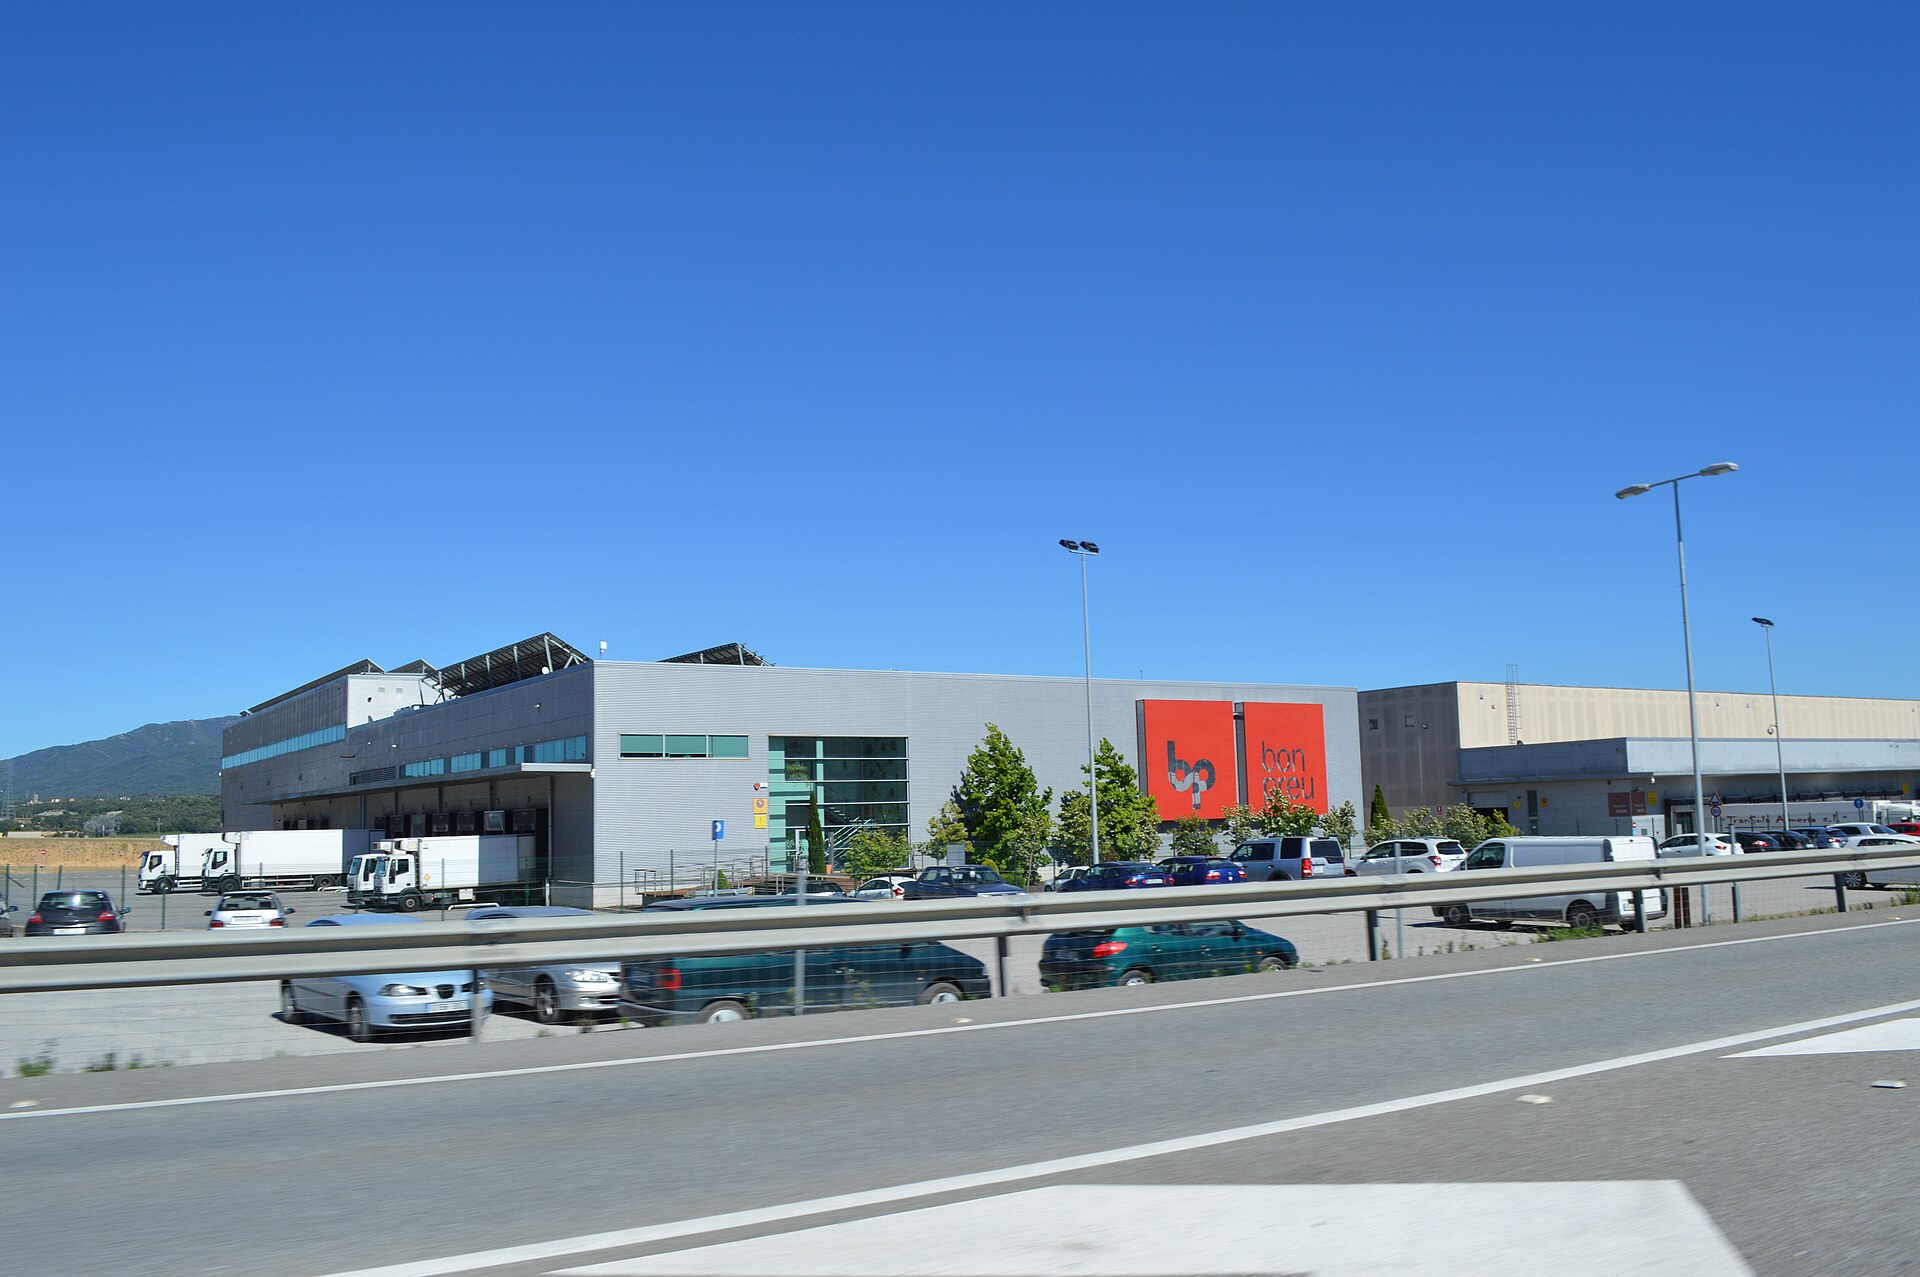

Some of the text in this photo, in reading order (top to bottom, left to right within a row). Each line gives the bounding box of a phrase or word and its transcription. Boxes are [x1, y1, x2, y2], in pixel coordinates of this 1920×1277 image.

[1261, 741, 1306, 773] bon
[1167, 741, 1216, 810] bp
[1263, 775, 1315, 807] preu
